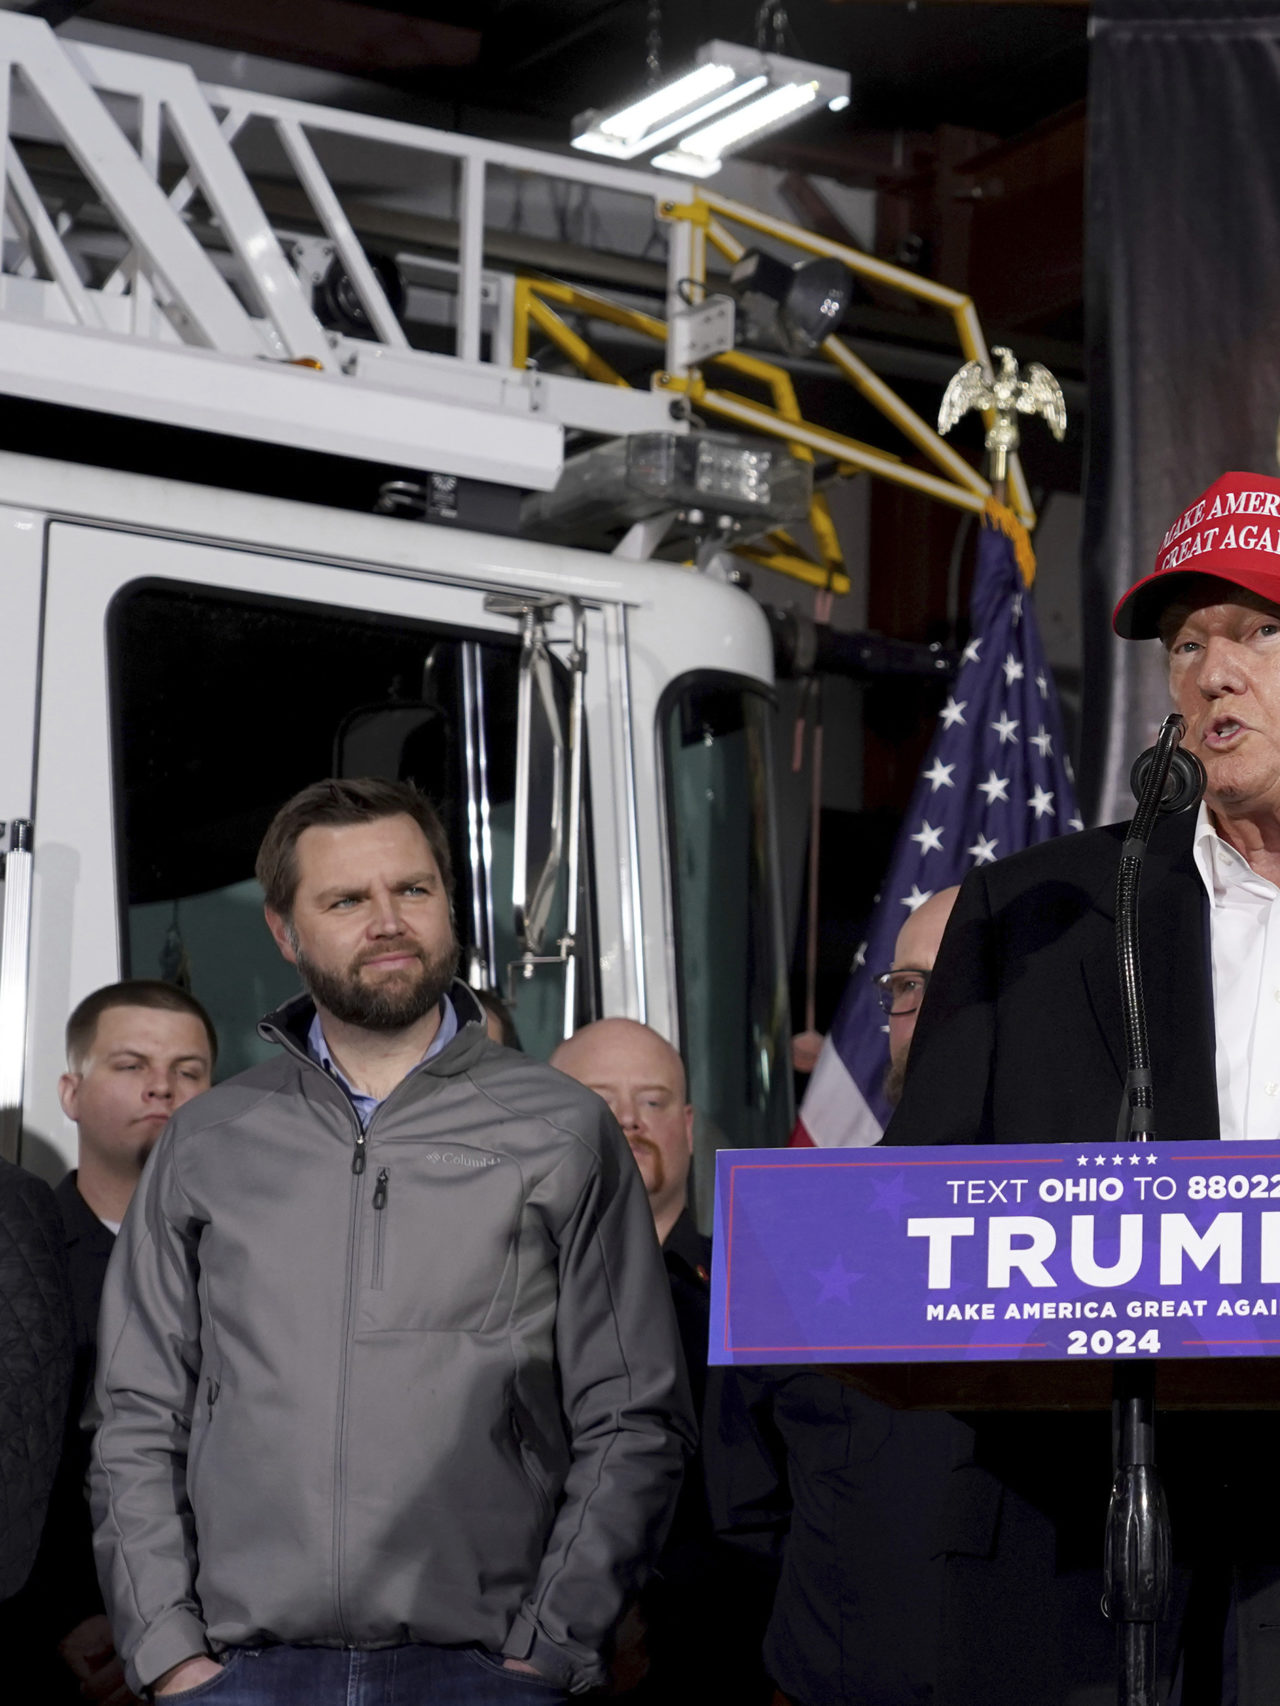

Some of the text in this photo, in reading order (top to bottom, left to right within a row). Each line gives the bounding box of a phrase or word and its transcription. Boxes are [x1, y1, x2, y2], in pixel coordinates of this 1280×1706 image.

[1158, 499, 1206, 555] MAKE
[1161, 527, 1220, 571] GREAT
[947, 1179, 1029, 1205] TEXT
[1038, 1177, 1124, 1203] OHIO
[1134, 1176, 1177, 1201] TO
[926, 1303, 995, 1321] MAKE
[1004, 1301, 1118, 1320] AMERICA
[1126, 1299, 1208, 1318] GREAT
[1066, 1328, 1161, 1355] 2024
